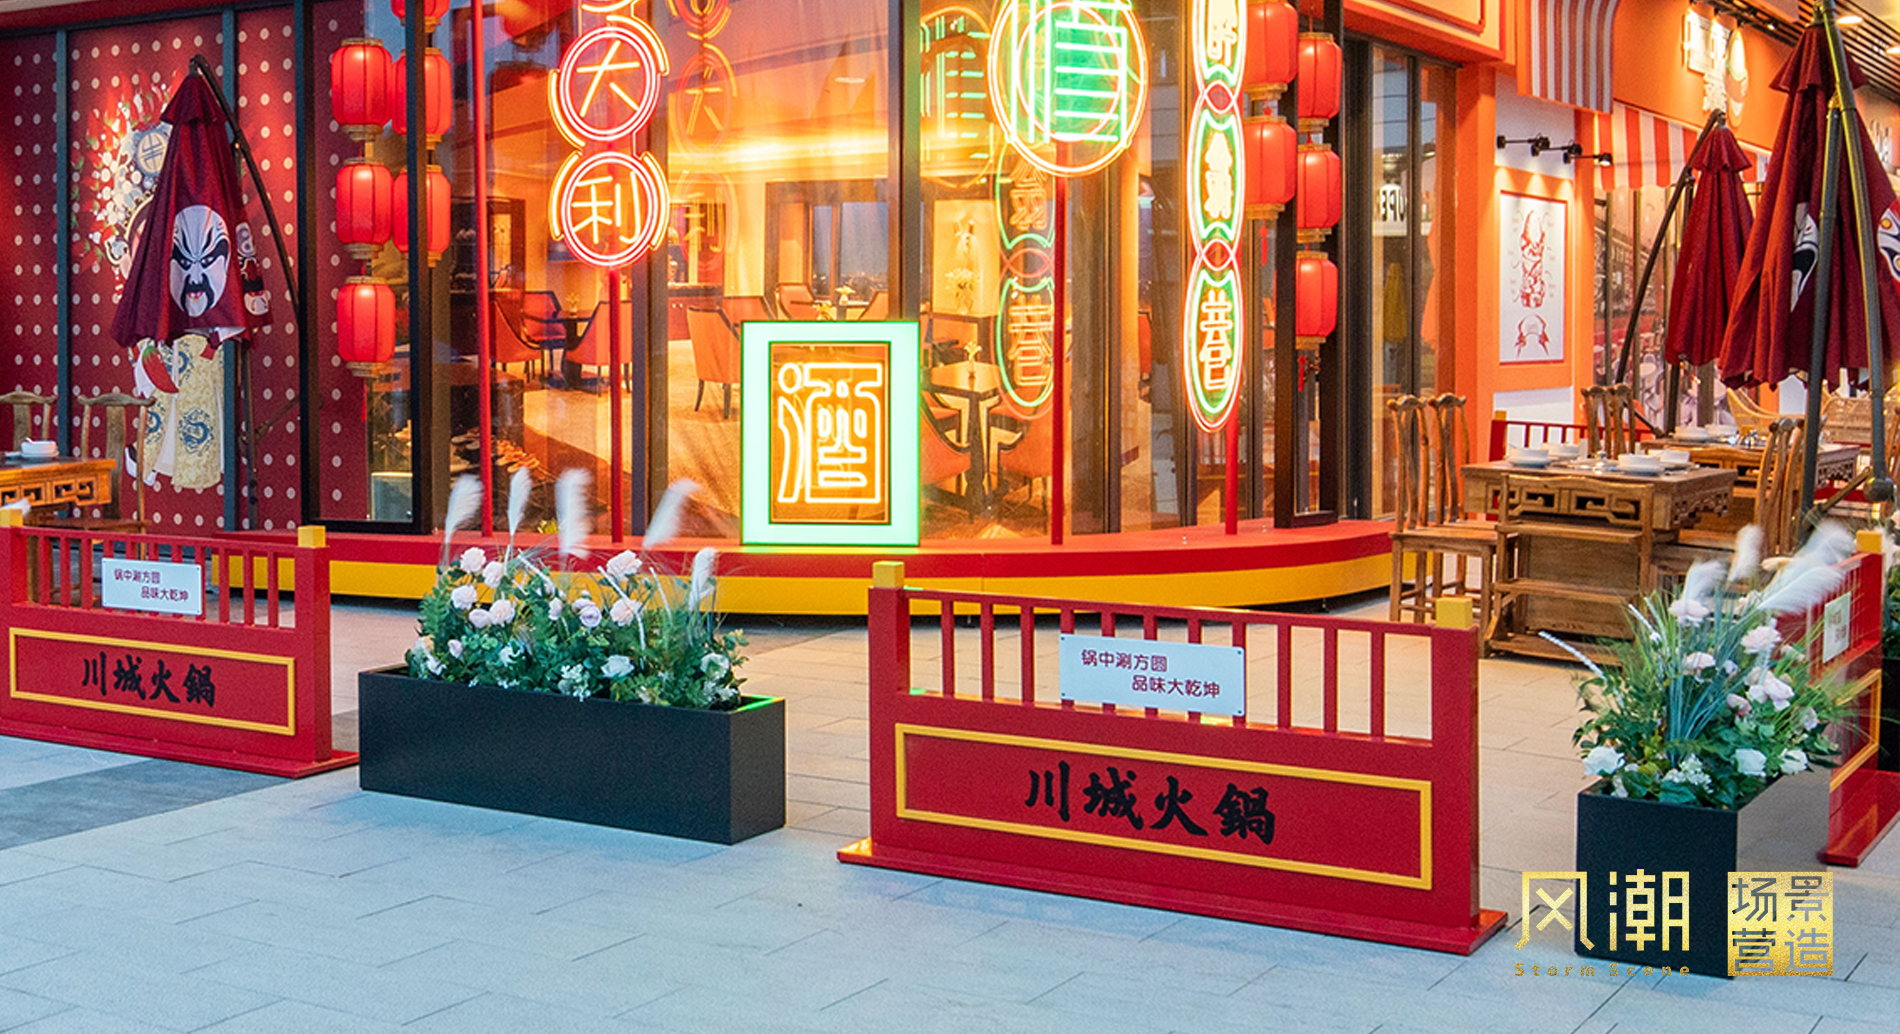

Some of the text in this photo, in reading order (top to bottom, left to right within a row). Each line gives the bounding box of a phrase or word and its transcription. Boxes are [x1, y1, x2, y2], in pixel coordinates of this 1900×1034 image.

[777, 362, 883, 504] 酒
[81, 651, 217, 707] 川城火鍋
[1081, 649, 1168, 673] 锅中涮方圆
[1132, 674, 1221, 699] 品味大乾坤
[1024, 760, 1276, 845] 川城火鍋
